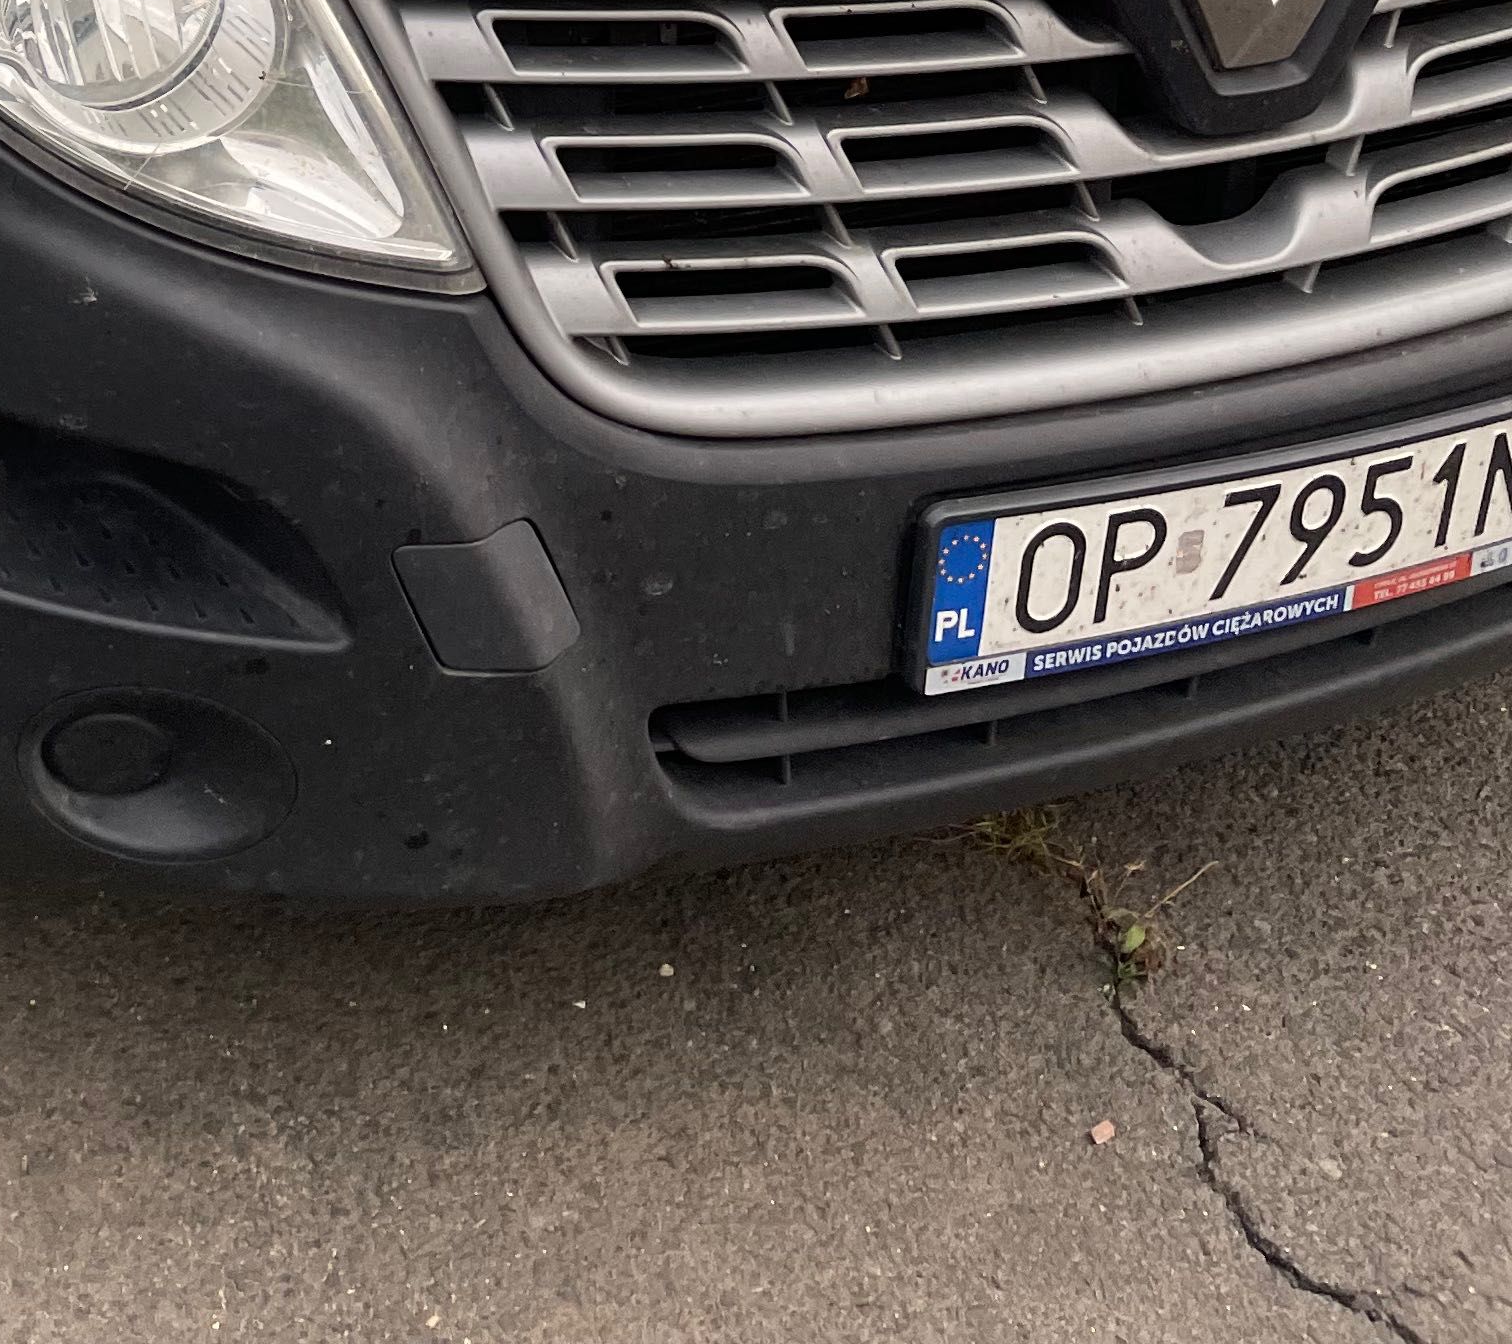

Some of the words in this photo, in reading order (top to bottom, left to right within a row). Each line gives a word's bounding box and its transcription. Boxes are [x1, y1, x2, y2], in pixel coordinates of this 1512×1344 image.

[1016, 508, 1167, 634] OP
[934, 608, 975, 642] PL
[1033, 644, 1102, 671] SERWIS
[1106, 623, 1210, 659] POJAZDÓW
[1211, 593, 1339, 636] CIĘŻAROWYCH
[960, 659, 1009, 681] KANO
